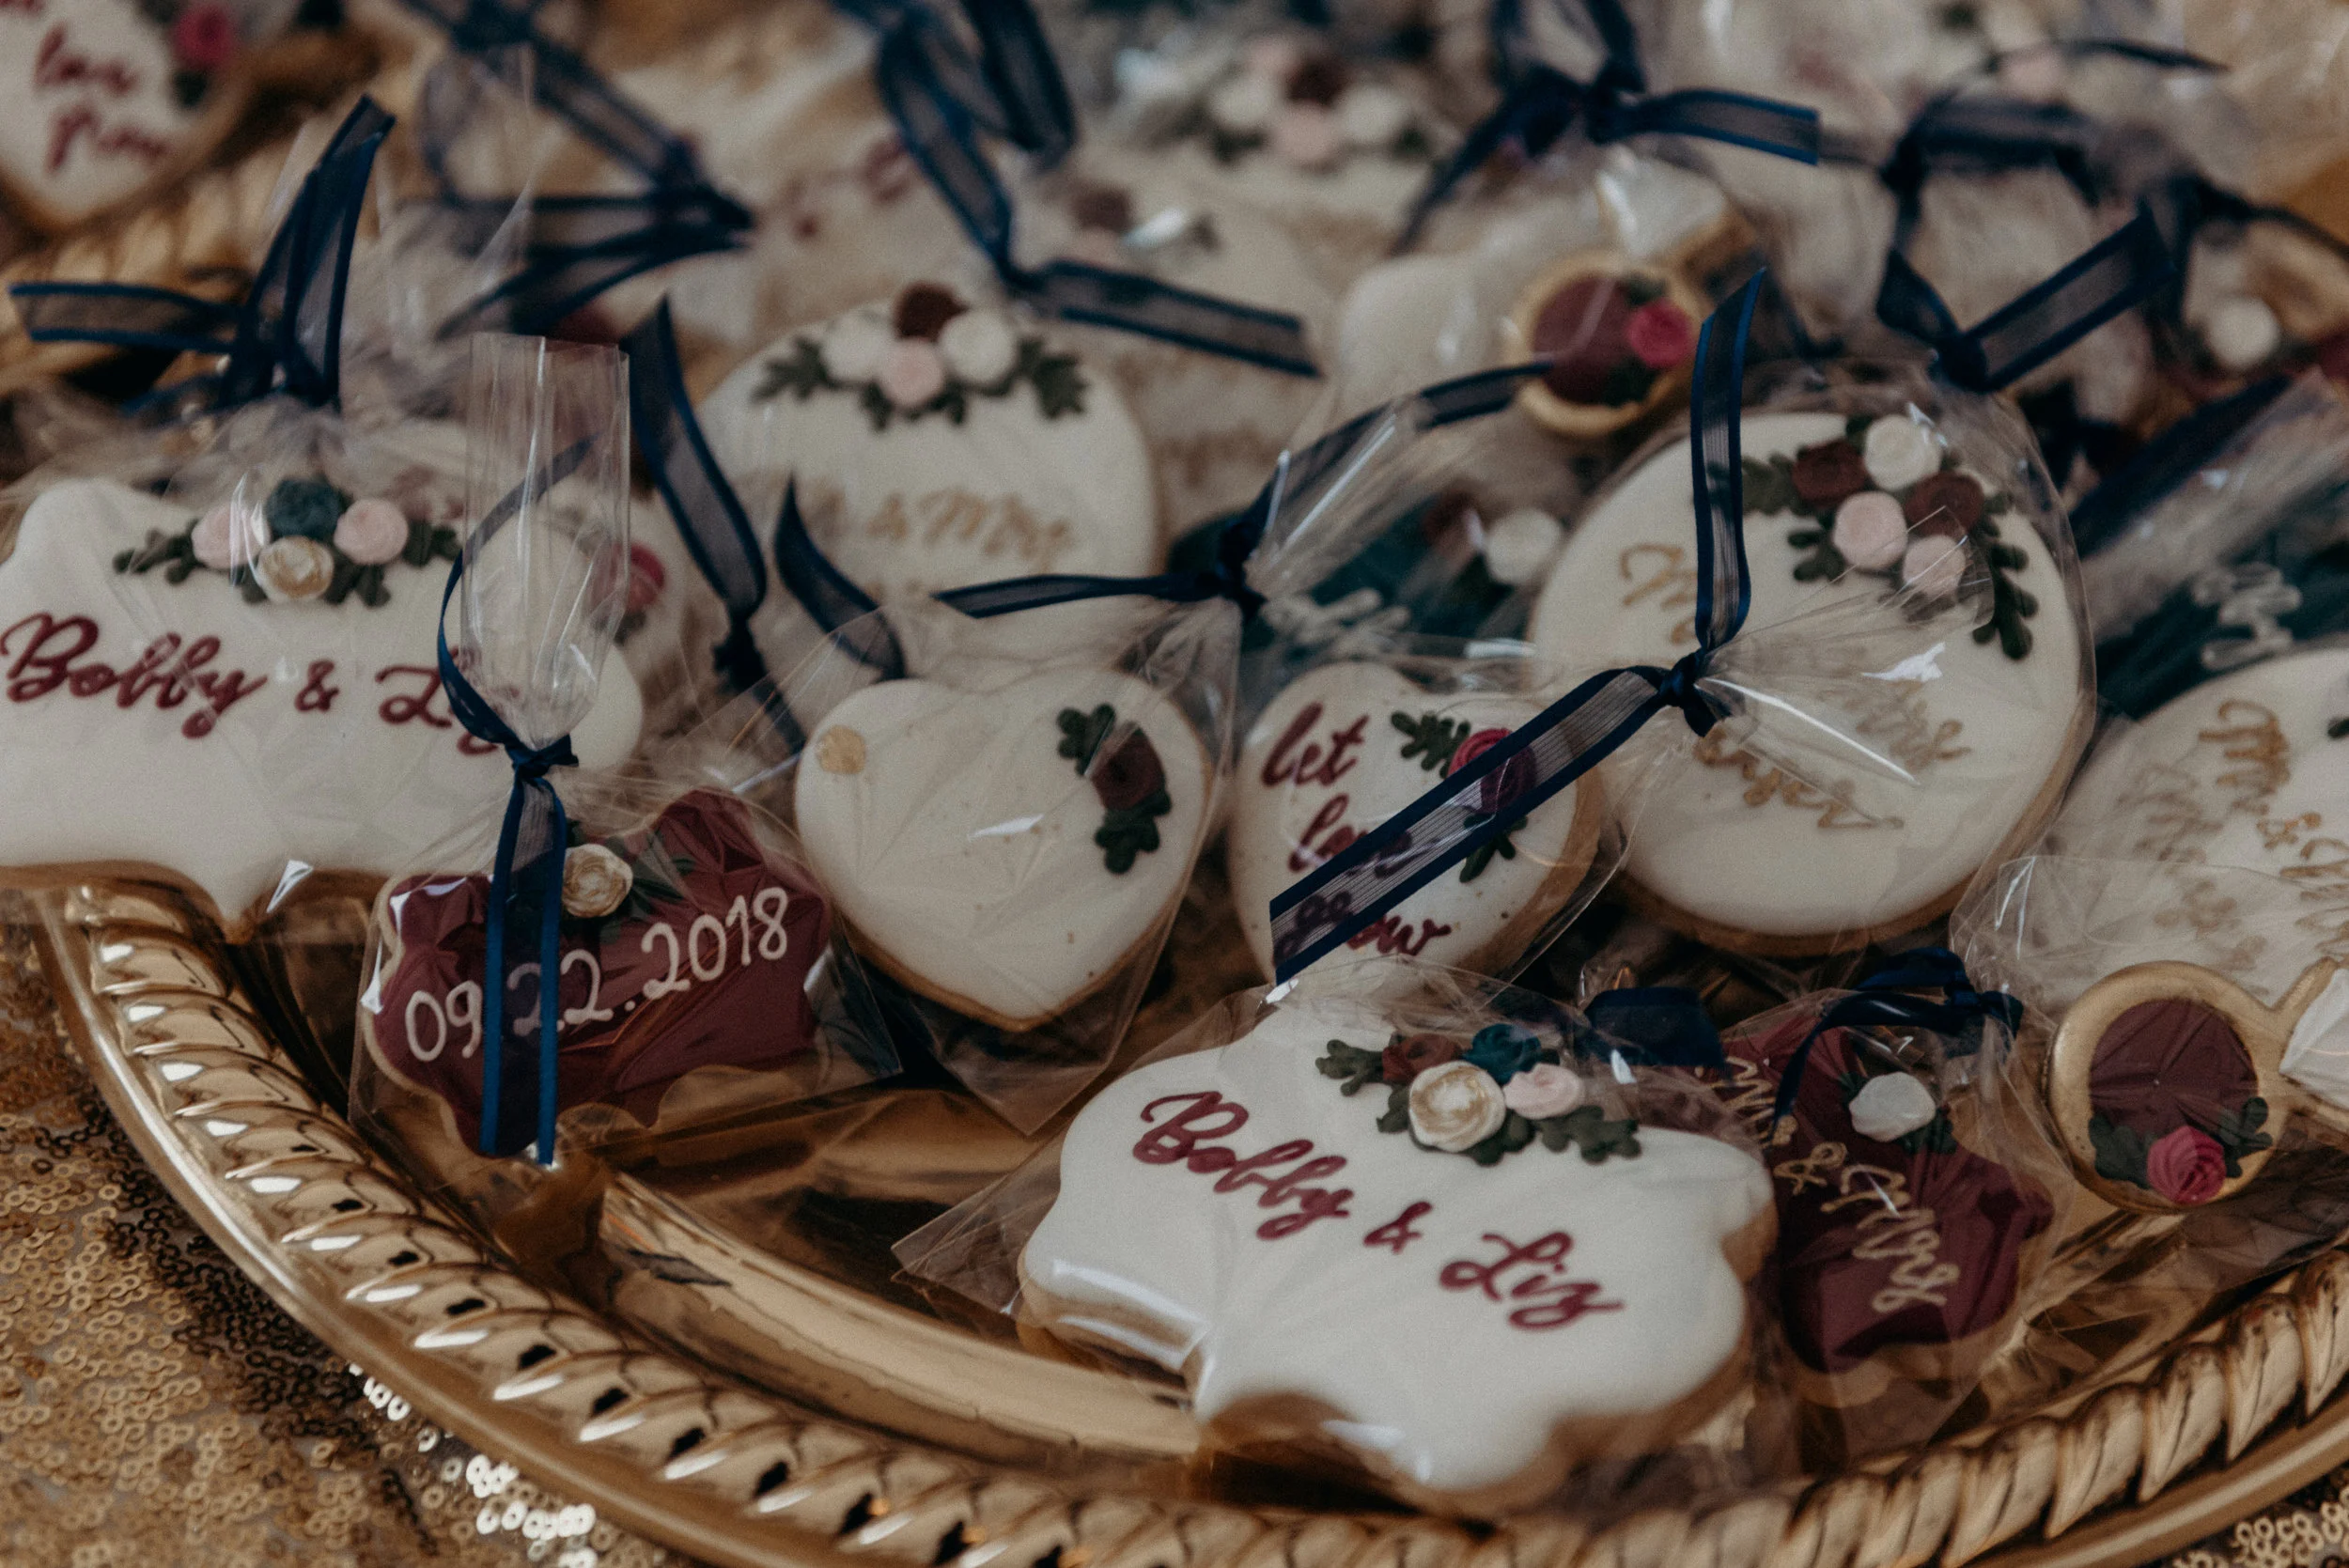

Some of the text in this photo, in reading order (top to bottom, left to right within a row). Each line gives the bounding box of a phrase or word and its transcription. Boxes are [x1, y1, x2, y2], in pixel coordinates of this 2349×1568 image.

[0, 613, 267, 738] Bobby
[294, 660, 339, 712] &
[1261, 702, 1370, 787] let
[404, 886, 789, 1063] 0922.2018
[1132, 1090, 1355, 1241] Bobby
[1362, 1200, 1433, 1254] &
[1774, 1141, 1848, 1196] &
